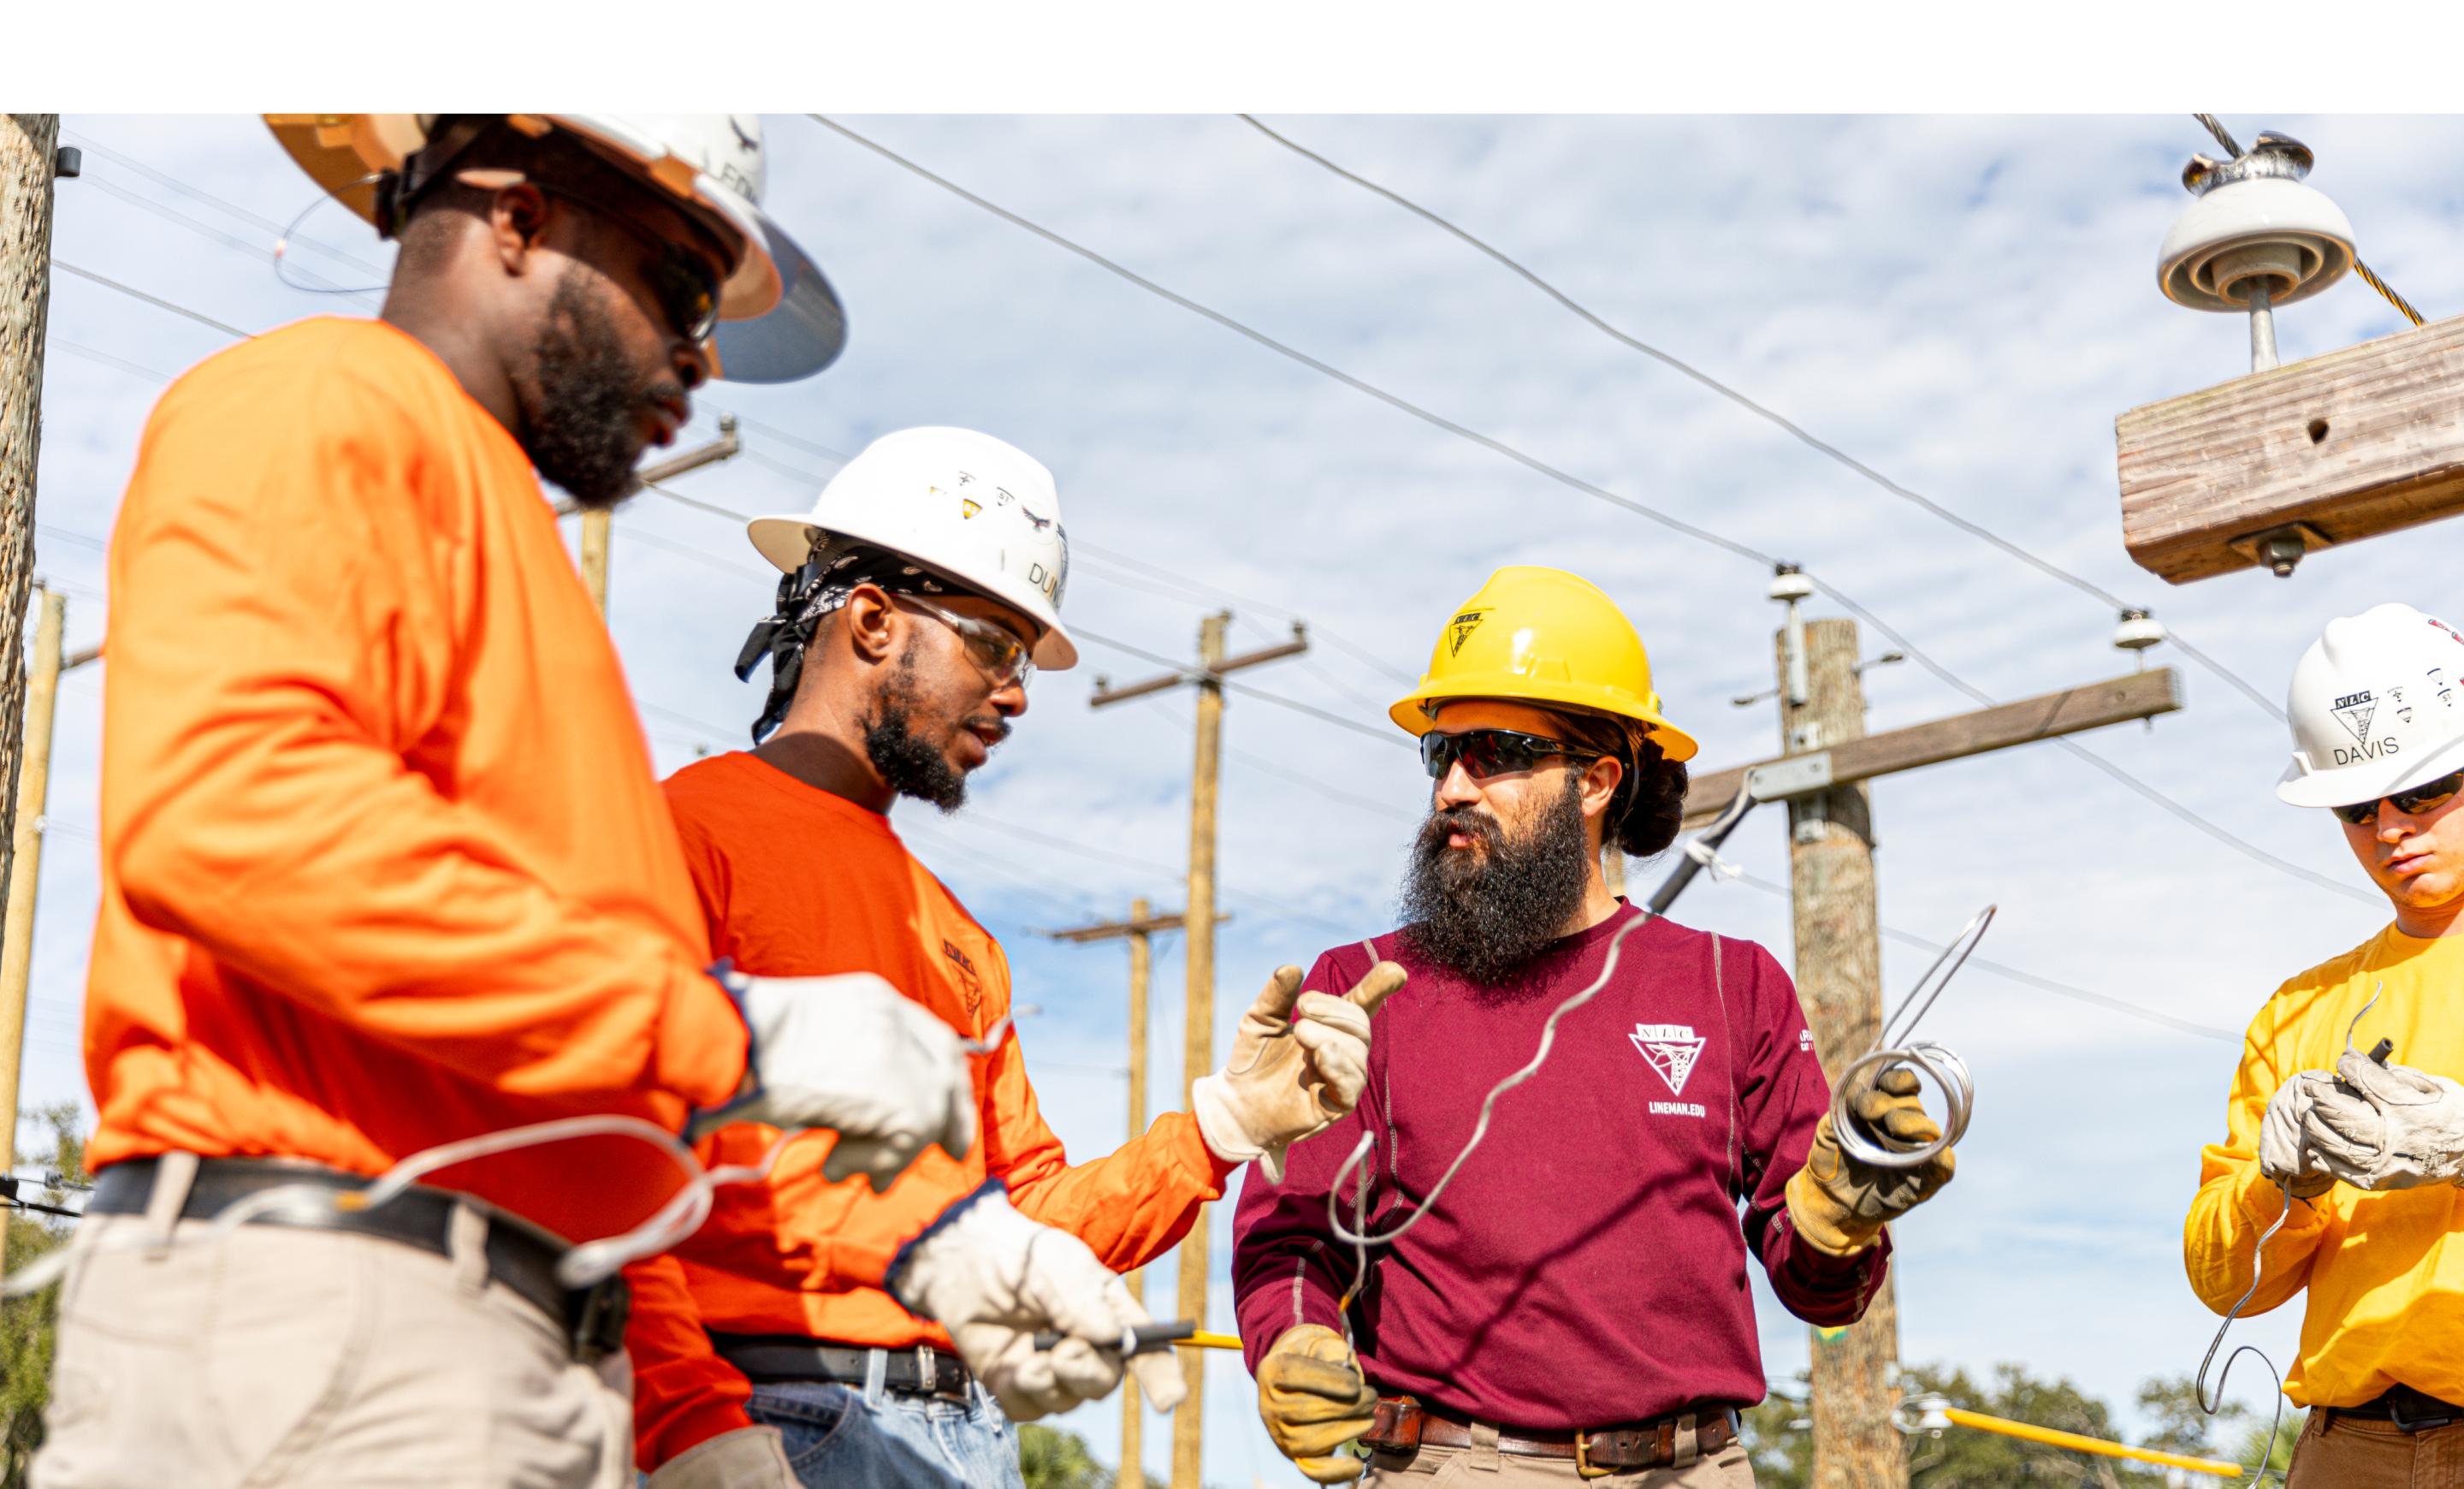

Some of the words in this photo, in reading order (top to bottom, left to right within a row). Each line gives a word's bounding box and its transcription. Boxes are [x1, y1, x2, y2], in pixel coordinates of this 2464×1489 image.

[998, 493, 1010, 502] S1
[963, 503, 978, 514] S3
[2337, 691, 2371, 709] NLC
[2334, 737, 2399, 766] DAVIS
[1639, 1026, 1692, 1041] NLC
[1649, 1101, 1705, 1118] LINEMAN.EDU
